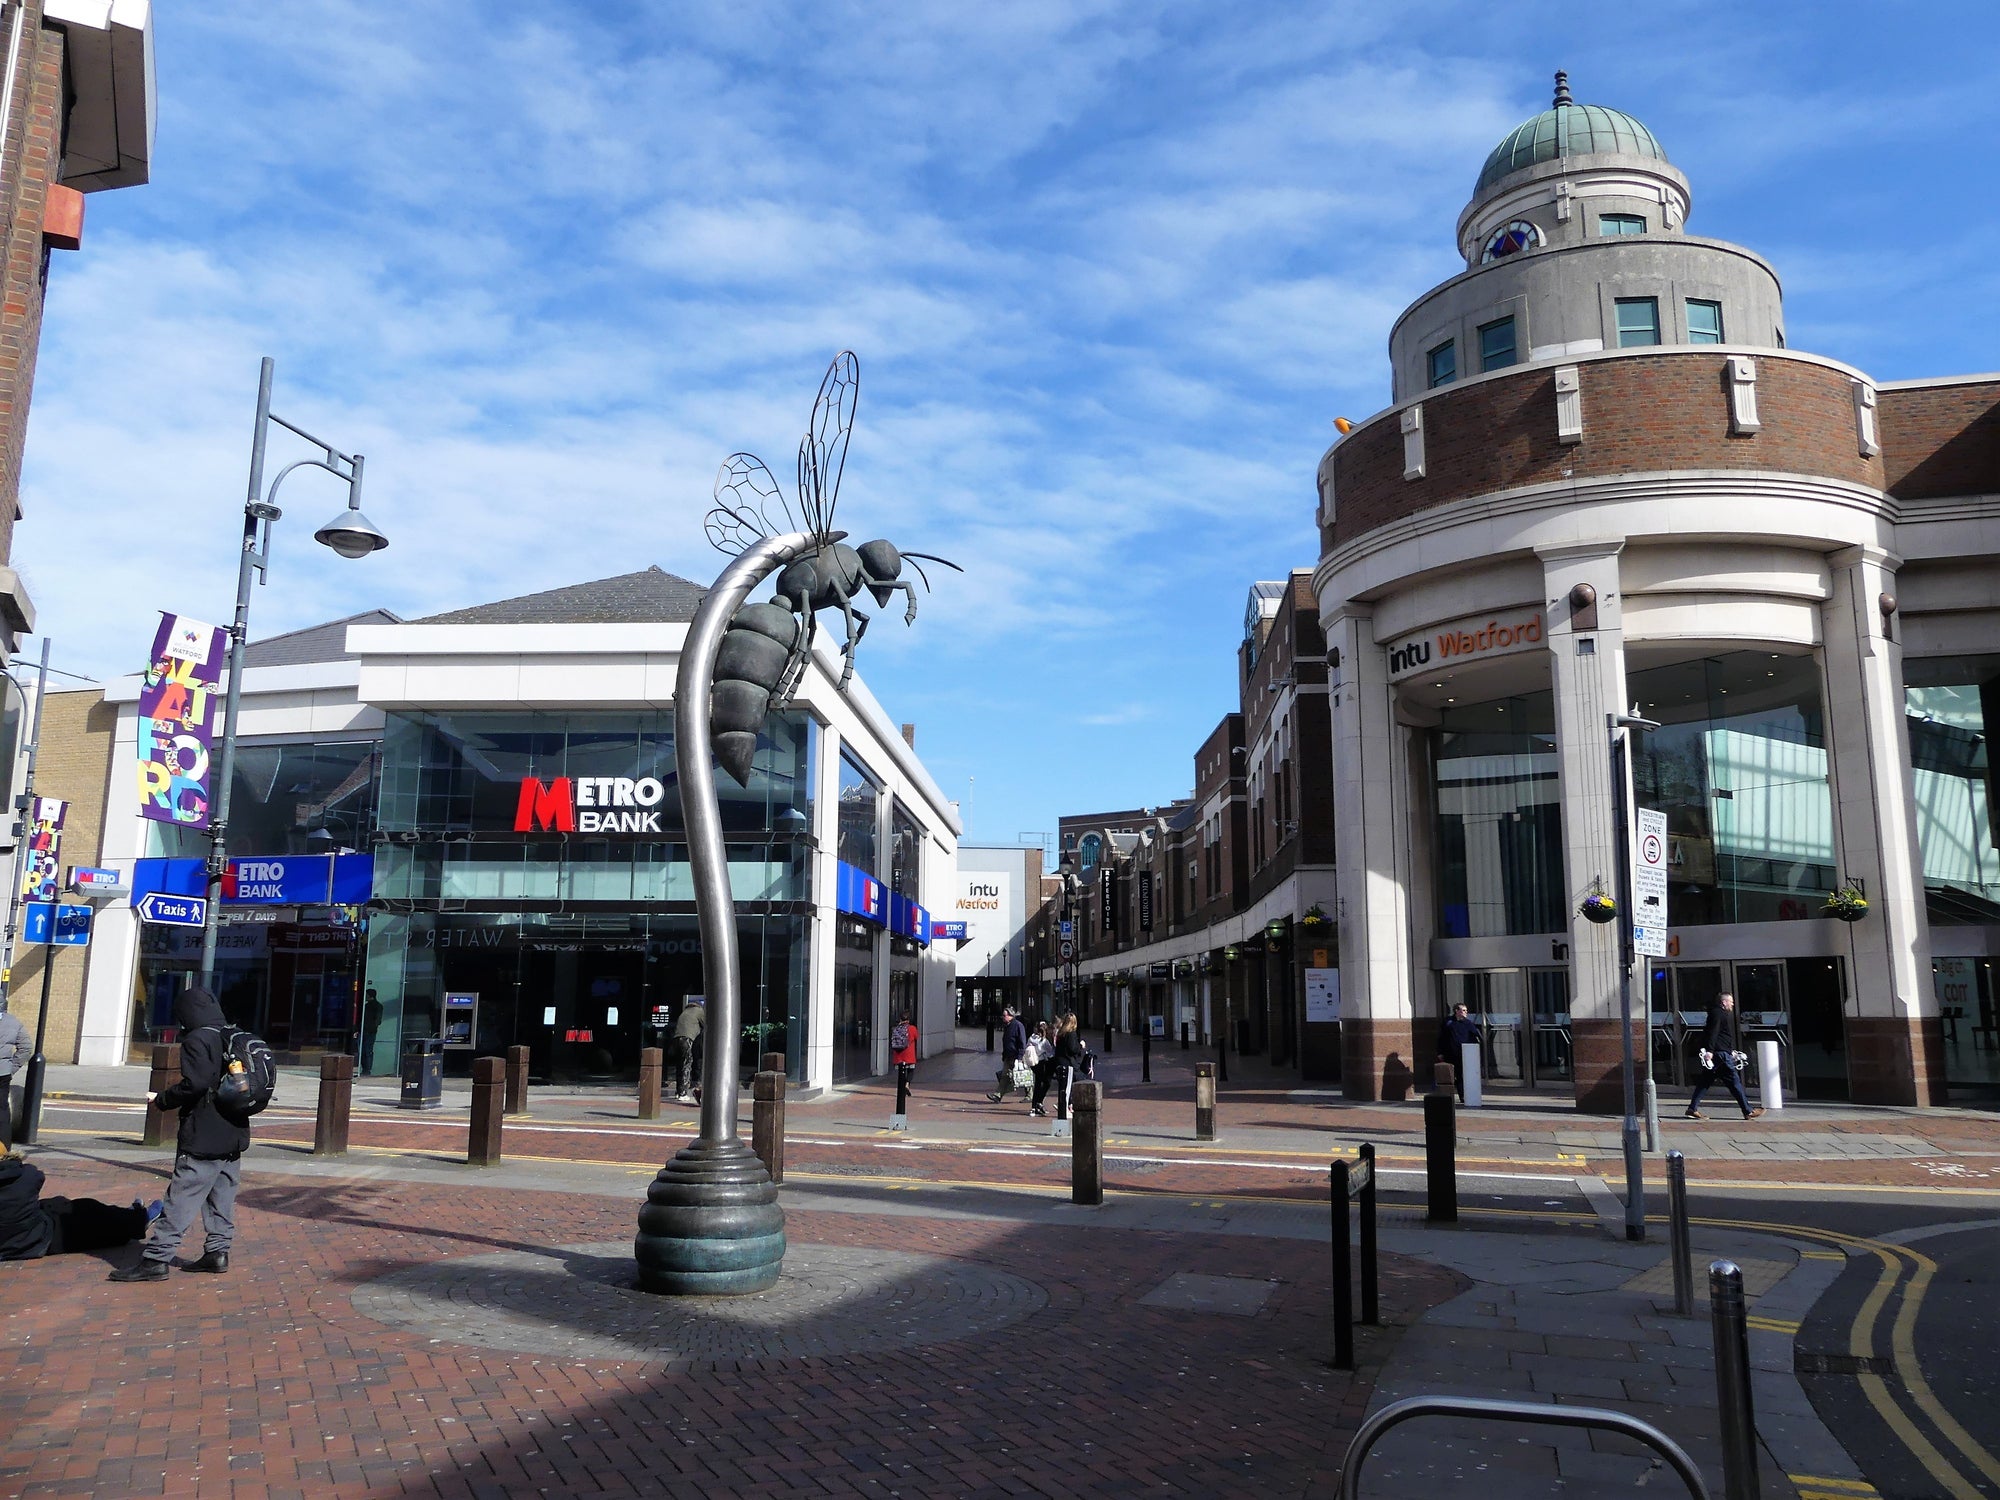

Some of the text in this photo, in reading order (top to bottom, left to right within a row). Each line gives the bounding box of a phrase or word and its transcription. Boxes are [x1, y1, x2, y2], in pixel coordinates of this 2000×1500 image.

[1390, 612, 1541, 674] intu Watford
[172, 646, 203, 659] WATFORD
[579, 811, 662, 832] BANK
[1643, 823, 1662, 834] ZONE
[79, 872, 116, 884] METRO
[238, 884, 283, 898] BANK
[969, 882, 998, 897] intu
[157, 901, 187, 917] Taxis
[955, 898, 998, 910] Watford
[247, 910, 255, 921] 7
[255, 912, 277, 921] DAYS
[1063, 922, 1071, 932] P
